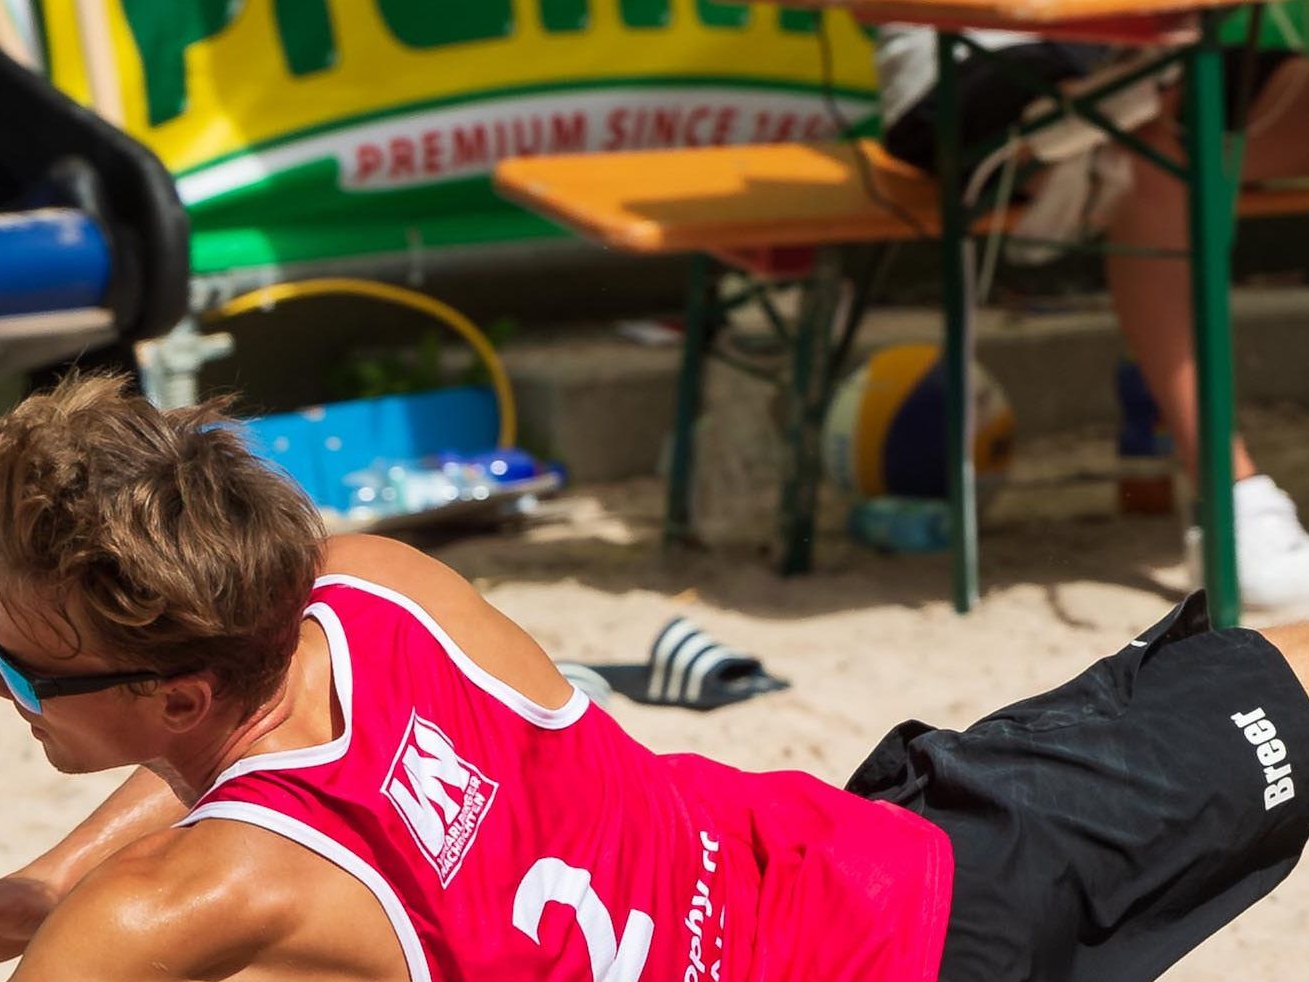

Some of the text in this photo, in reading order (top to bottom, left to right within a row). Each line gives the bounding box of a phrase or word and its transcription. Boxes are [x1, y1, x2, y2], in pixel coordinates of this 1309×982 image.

[355, 110, 586, 182] PREMIUM
[603, 105, 739, 151] SINCE
[1230, 707, 1295, 811] Breer
